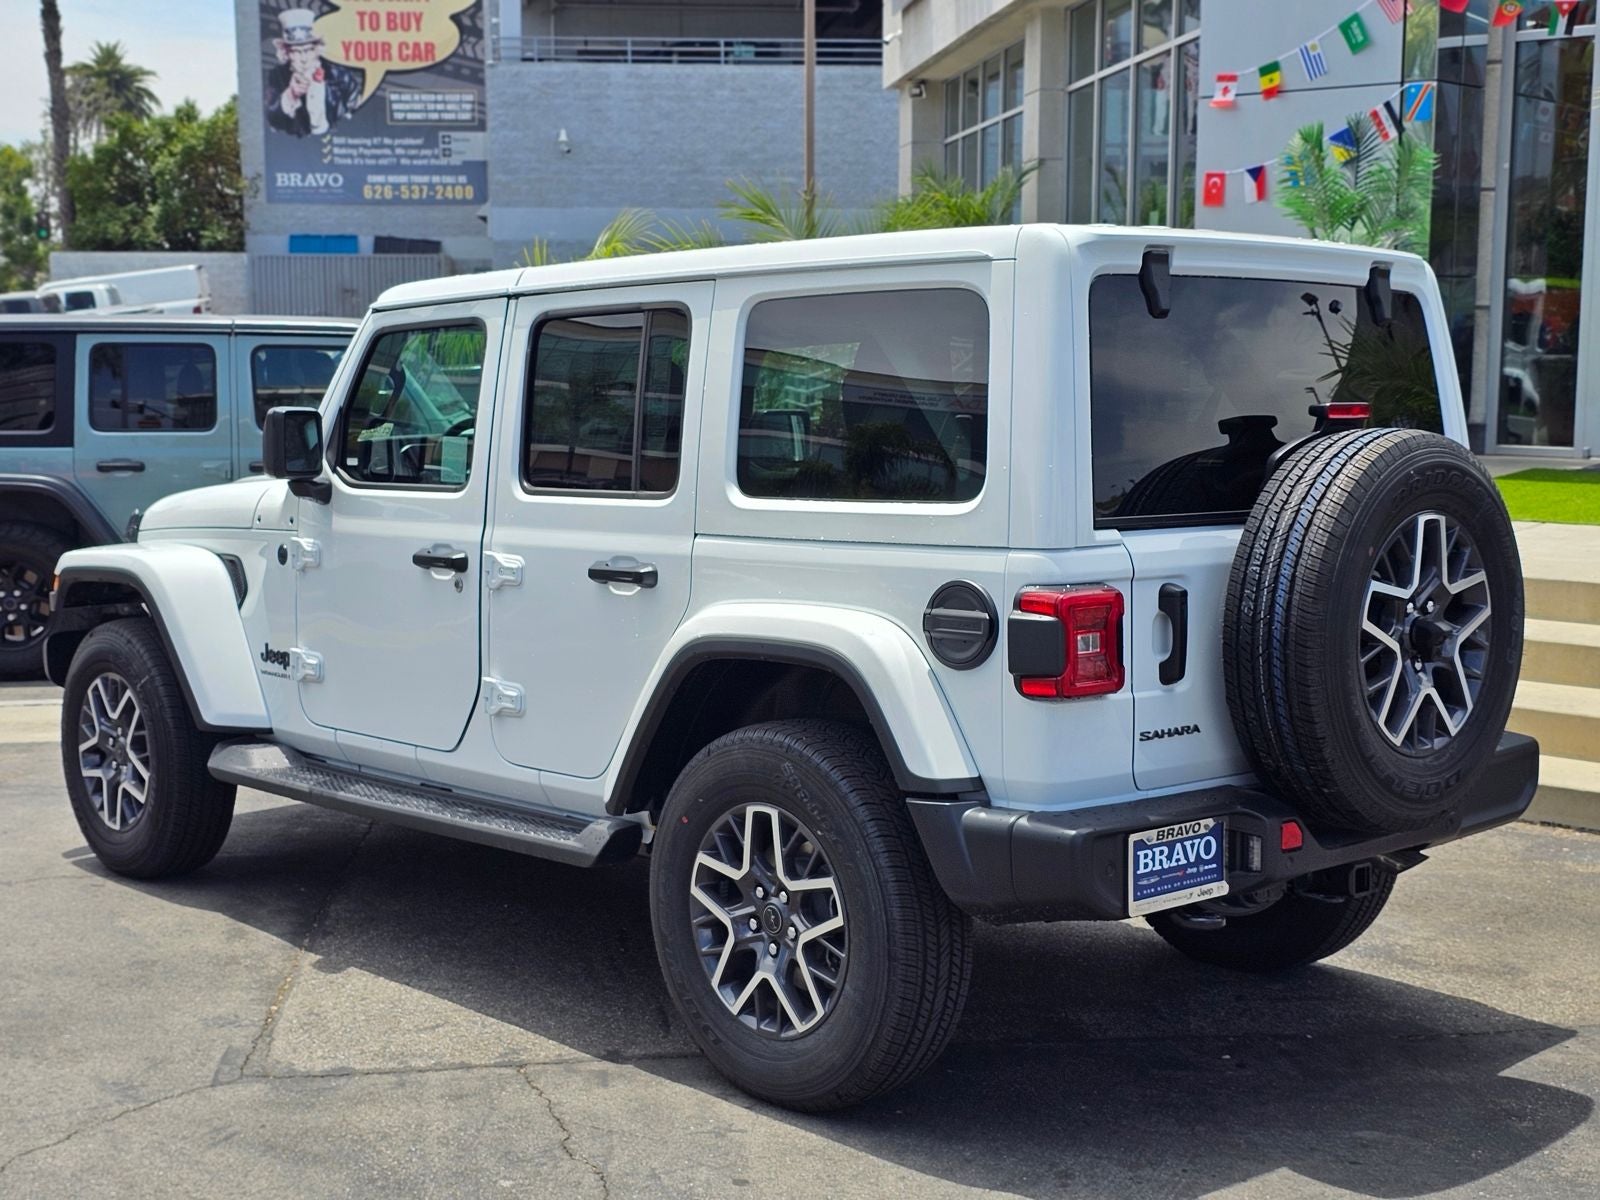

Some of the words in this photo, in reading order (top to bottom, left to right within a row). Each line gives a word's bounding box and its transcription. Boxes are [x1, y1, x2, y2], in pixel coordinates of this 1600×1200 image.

[356, 11, 380, 32] TO
[386, 11, 424, 32] BUY
[341, 40, 393, 62] YOUR
[398, 41, 436, 62] CAR
[275, 172, 344, 188] BRAVO
[260, 642, 290, 671] Jeep
[1139, 723, 1201, 741] SAHARA
[1156, 822, 1201, 841] BRAVO
[1136, 835, 1217, 874] BRAVO
[1197, 888, 1213, 897] Jeep
